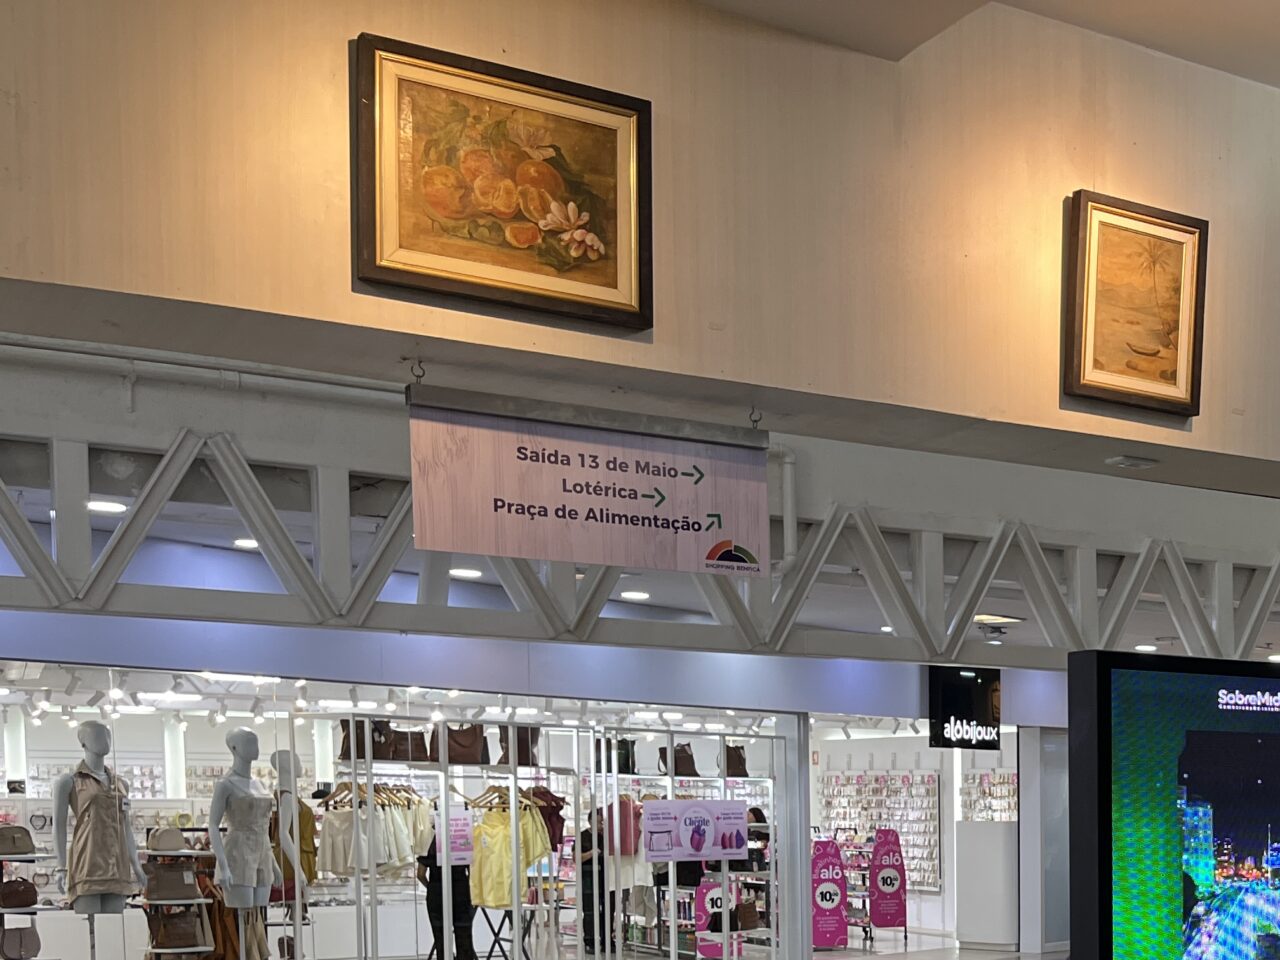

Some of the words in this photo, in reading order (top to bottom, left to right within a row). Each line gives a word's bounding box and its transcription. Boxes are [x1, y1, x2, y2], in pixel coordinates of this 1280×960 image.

[516, 446, 571, 466] Saída
[578, 453, 600, 469] 13
[606, 457, 629, 472] de
[635, 460, 678, 478] Maio
[562, 478, 638, 500] Lotérica
[493, 498, 548, 520] Praça
[554, 504, 578, 520] de
[585, 507, 702, 534] Alimentação
[943, 715, 998, 744] alôbijoux
[881, 851, 901, 865] alô
[820, 865, 842, 879] alô
